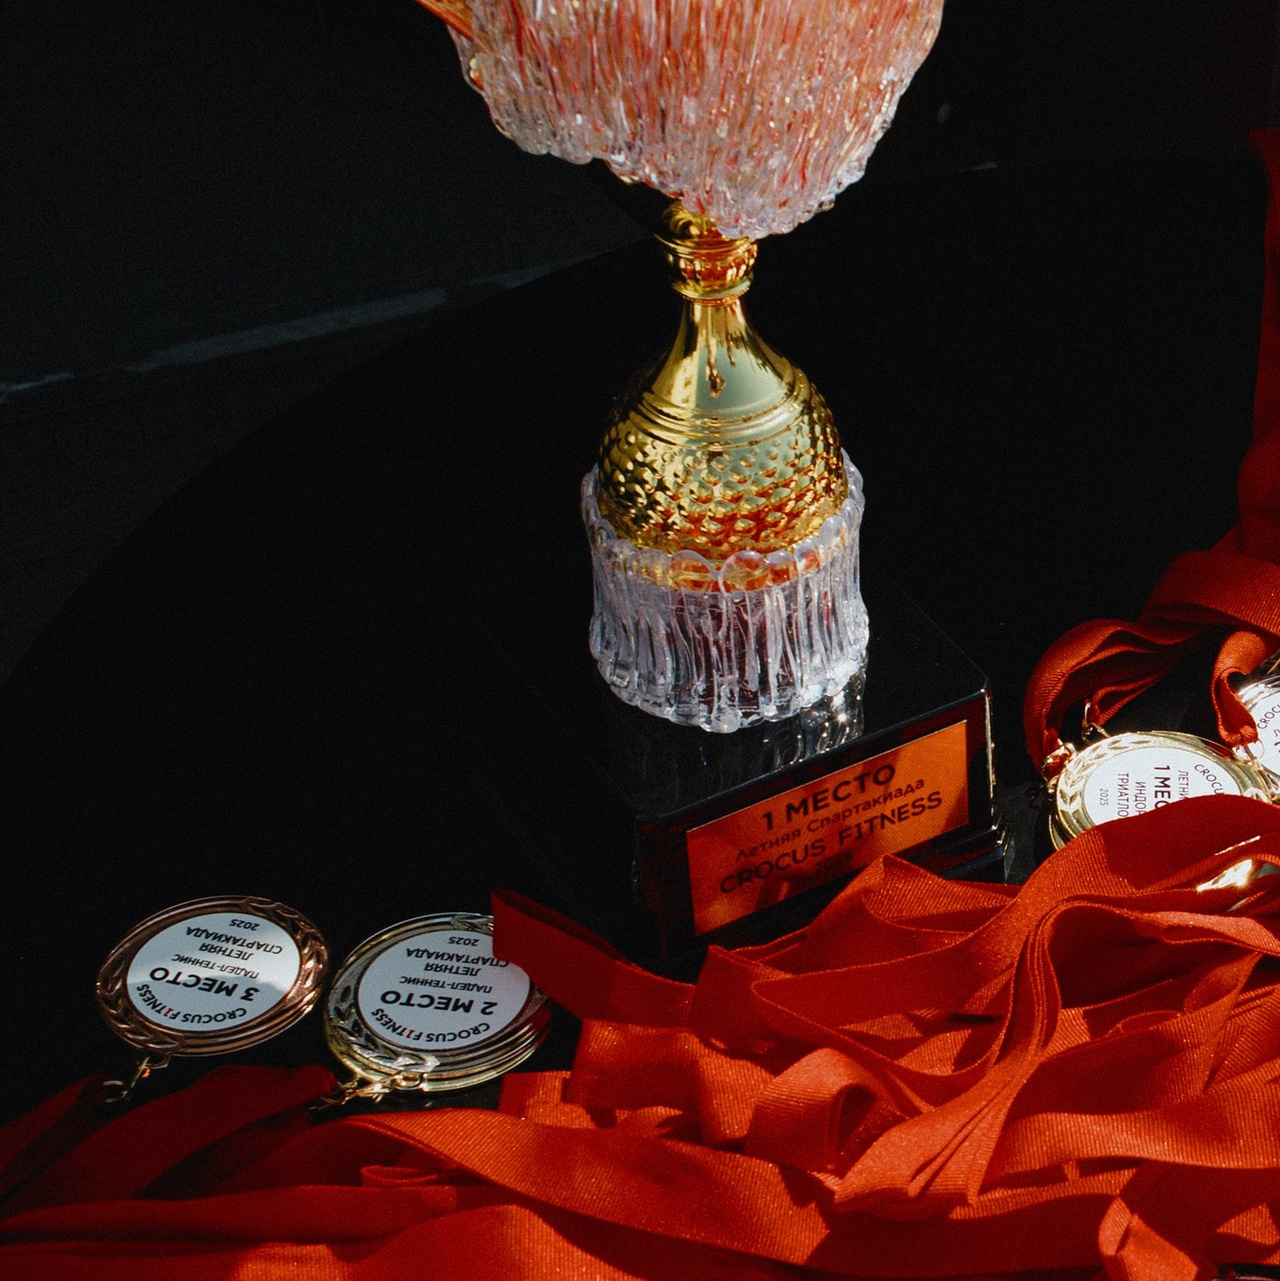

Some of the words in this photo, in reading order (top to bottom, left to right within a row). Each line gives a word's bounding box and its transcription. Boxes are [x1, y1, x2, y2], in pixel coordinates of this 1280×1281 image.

[762, 811, 773, 831] 1
[786, 764, 896, 820] МЕСТО
[1100, 788, 1109, 806] 2025
[736, 829, 801, 863] Летняя
[807, 779, 924, 833] Спартакиада
[720, 839, 826, 893] CROCUS
[229, 919, 260, 930] 2025
[186, 927, 283, 954] СПАРТАКИАДА
[448, 936, 479, 946] 2025
[199, 943, 253, 960] ЛЕТНЯЯ
[171, 954, 260, 979] ПАДЕЛ-ТЕННИС
[424, 963, 481, 976] ЛЕТНЯЯ
[150, 968, 238, 997] МЕСТО
[399, 976, 493, 993] ПАДЕЛ-ТЕННИС
[240, 987, 260, 1002] 3
[380, 991, 474, 1013] МЕСТО
[181, 1008, 247, 1023] CROCUS
[480, 1001, 498, 1015] 2
[426, 1023, 490, 1042] CROCUS
